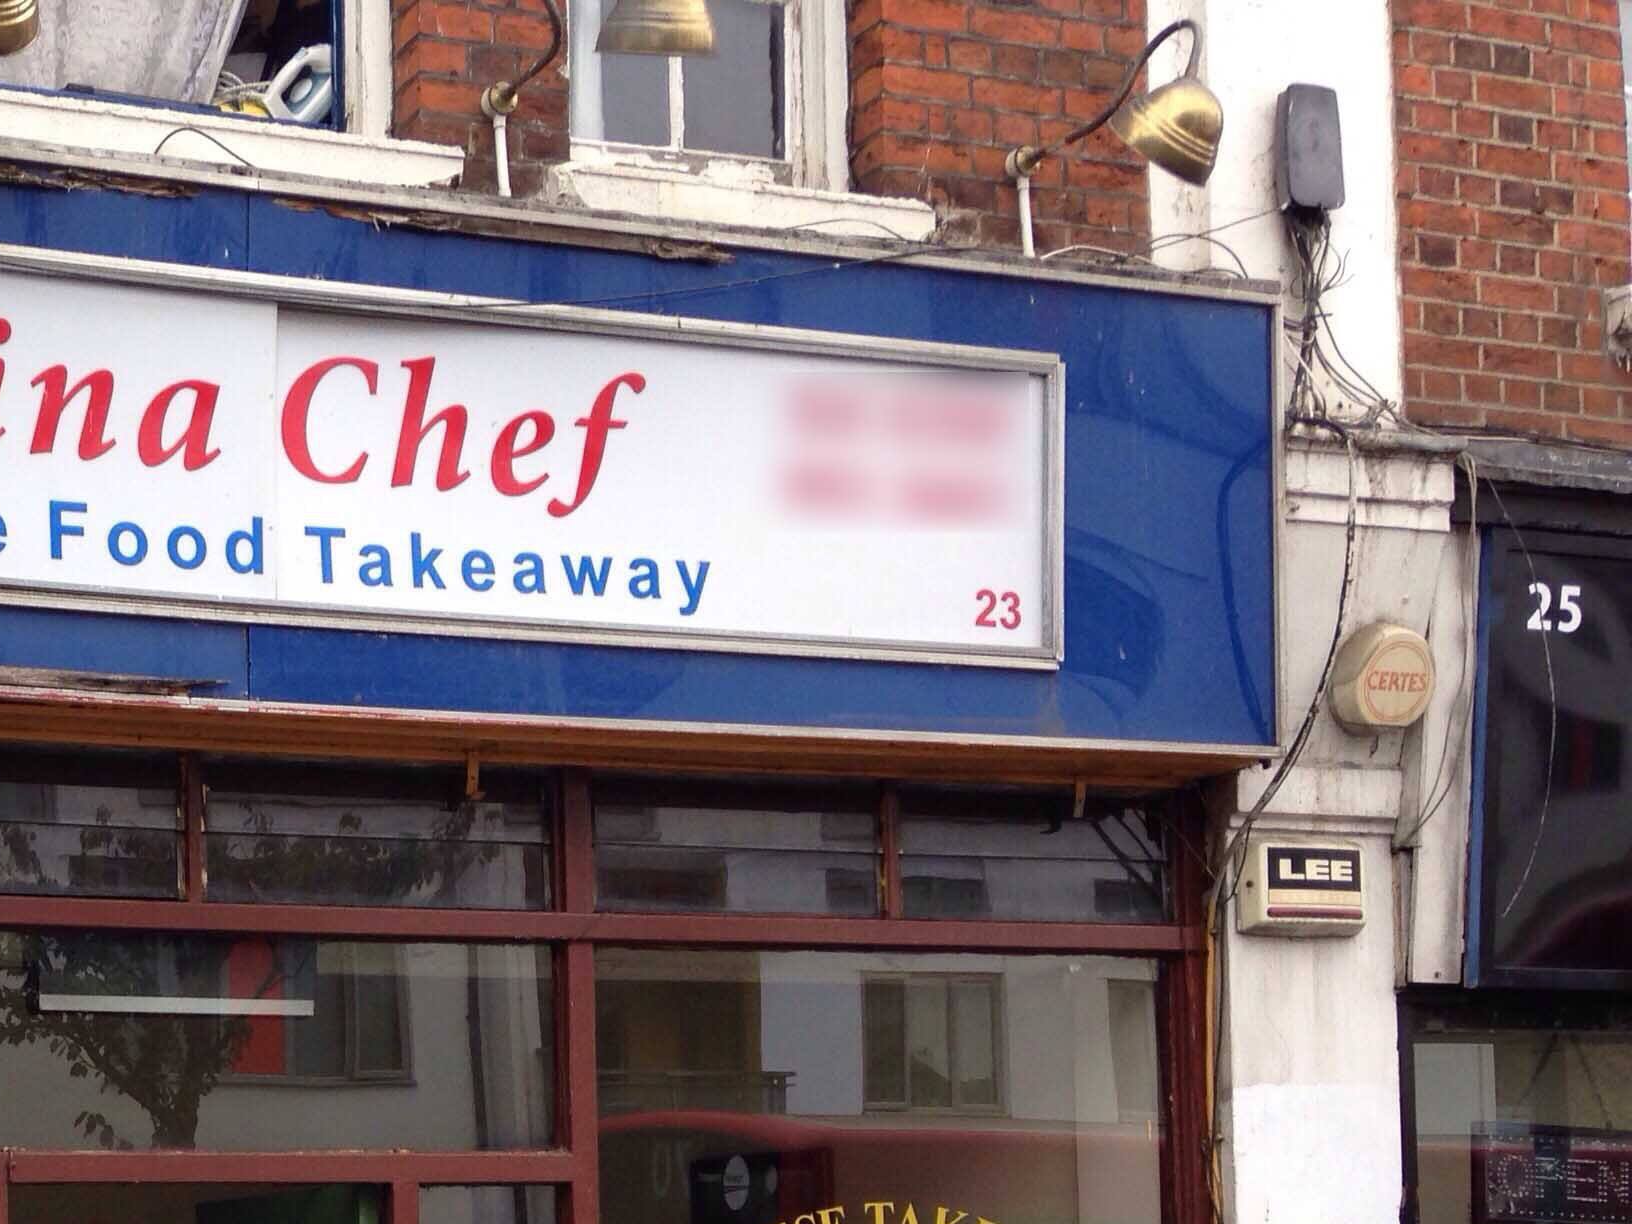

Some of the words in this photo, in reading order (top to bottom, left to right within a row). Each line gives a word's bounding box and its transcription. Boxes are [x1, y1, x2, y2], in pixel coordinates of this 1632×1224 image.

[280, 355, 646, 518] Chef
[50, 501, 265, 576] Food
[305, 526, 711, 615] Takeaway
[975, 589, 1022, 629] 23
[1526, 583, 1582, 632] 25
[1368, 669, 1427, 693] CERTES
[1279, 859, 1352, 882] LEE
